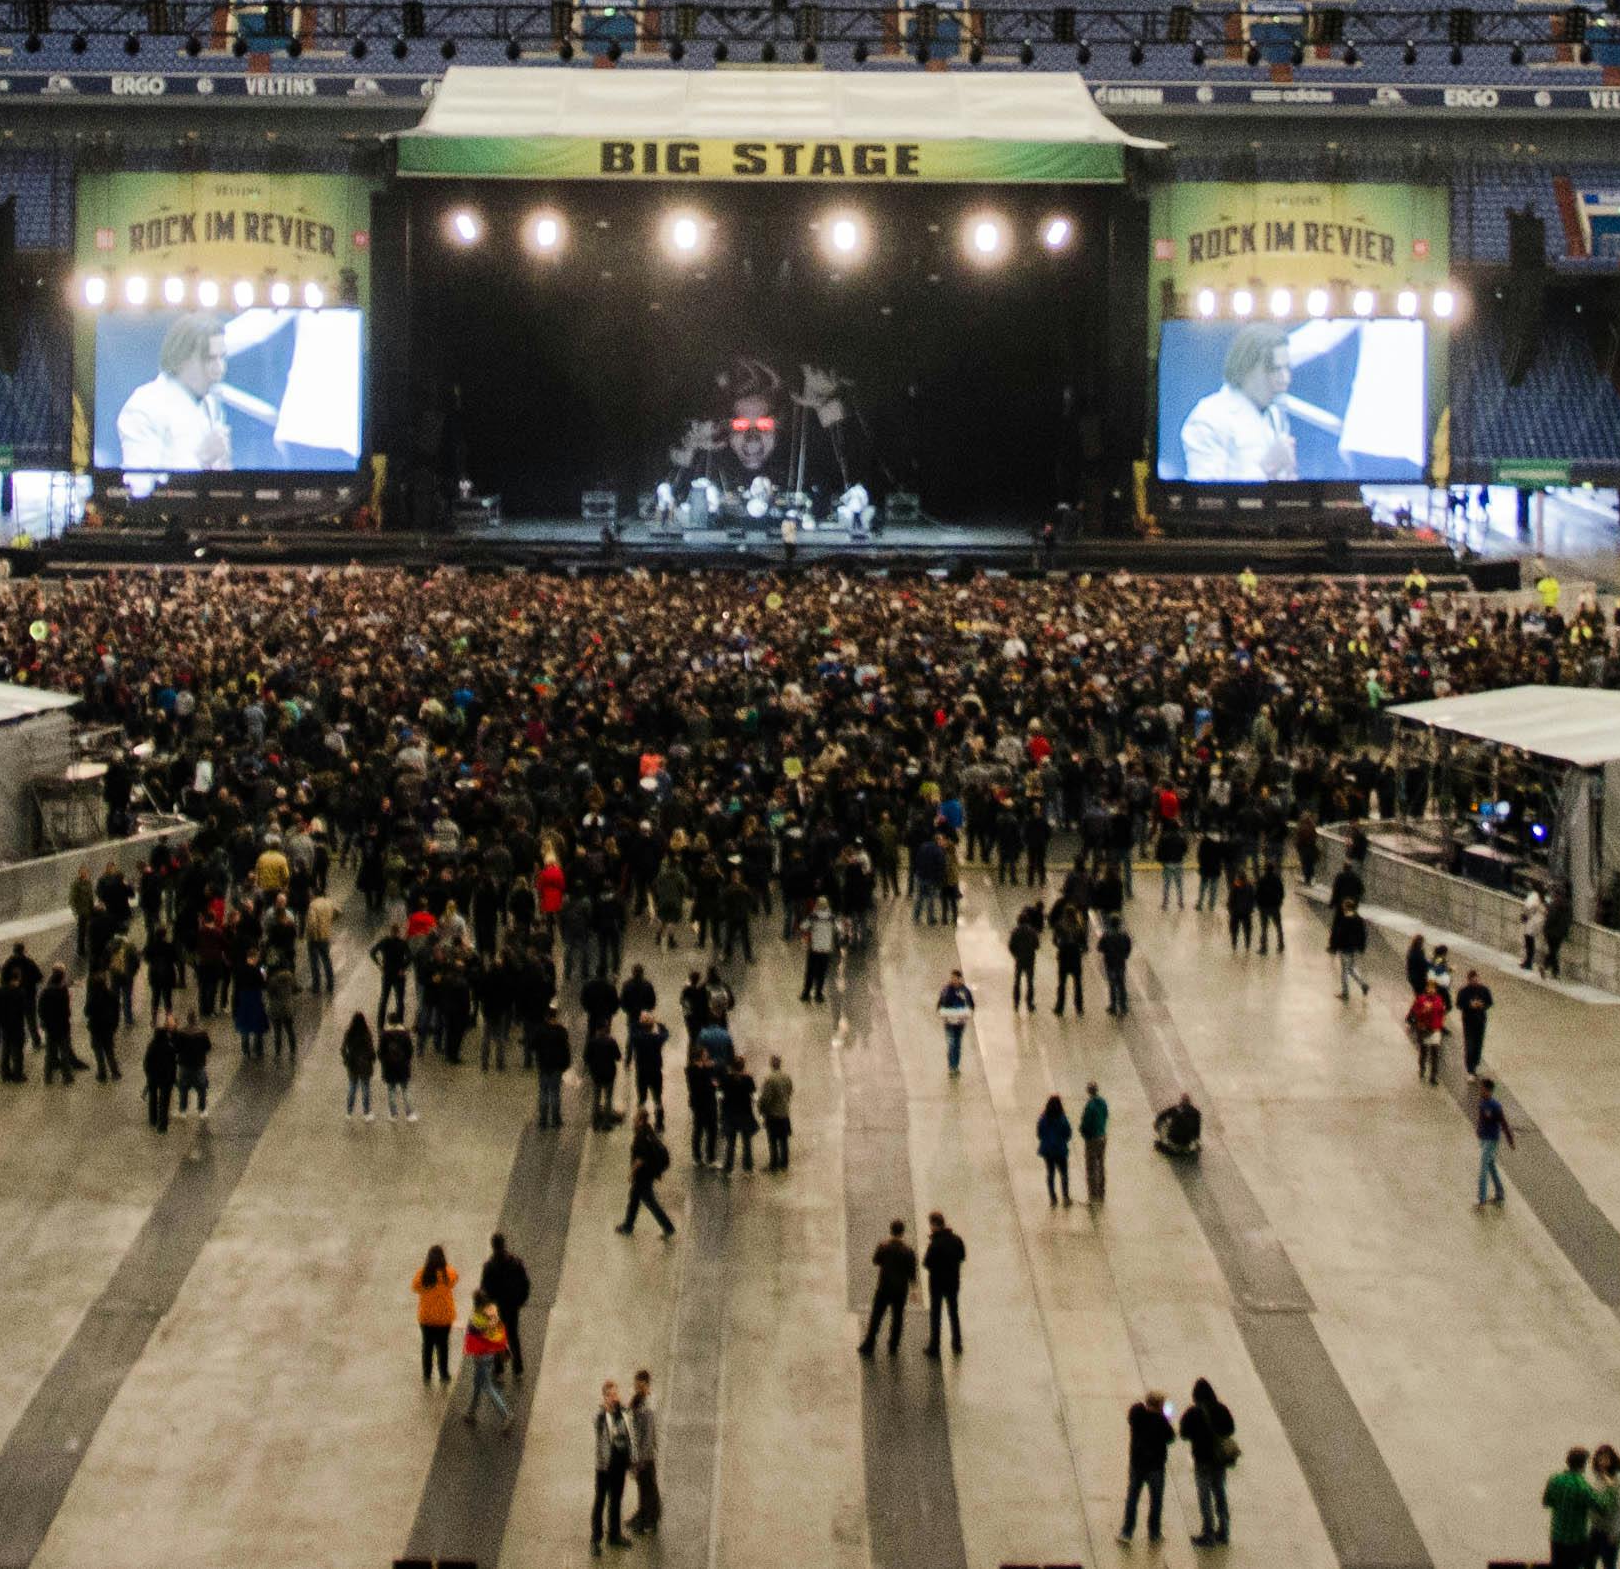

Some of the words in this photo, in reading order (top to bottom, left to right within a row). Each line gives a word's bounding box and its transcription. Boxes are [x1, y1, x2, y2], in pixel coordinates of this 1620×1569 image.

[110, 76, 167, 96] ERGO
[244, 76, 317, 96] VELTINS
[1443, 88, 1499, 108] ERGO
[601, 141, 701, 175] BIG
[732, 142, 919, 176] STAGE
[129, 211, 197, 257] ROCK
[204, 210, 235, 242] IM
[244, 211, 335, 258] REVIER
[1188, 222, 1257, 265] ROCK
[1265, 221, 1296, 252] IM
[1303, 222, 1395, 267] REVIER
